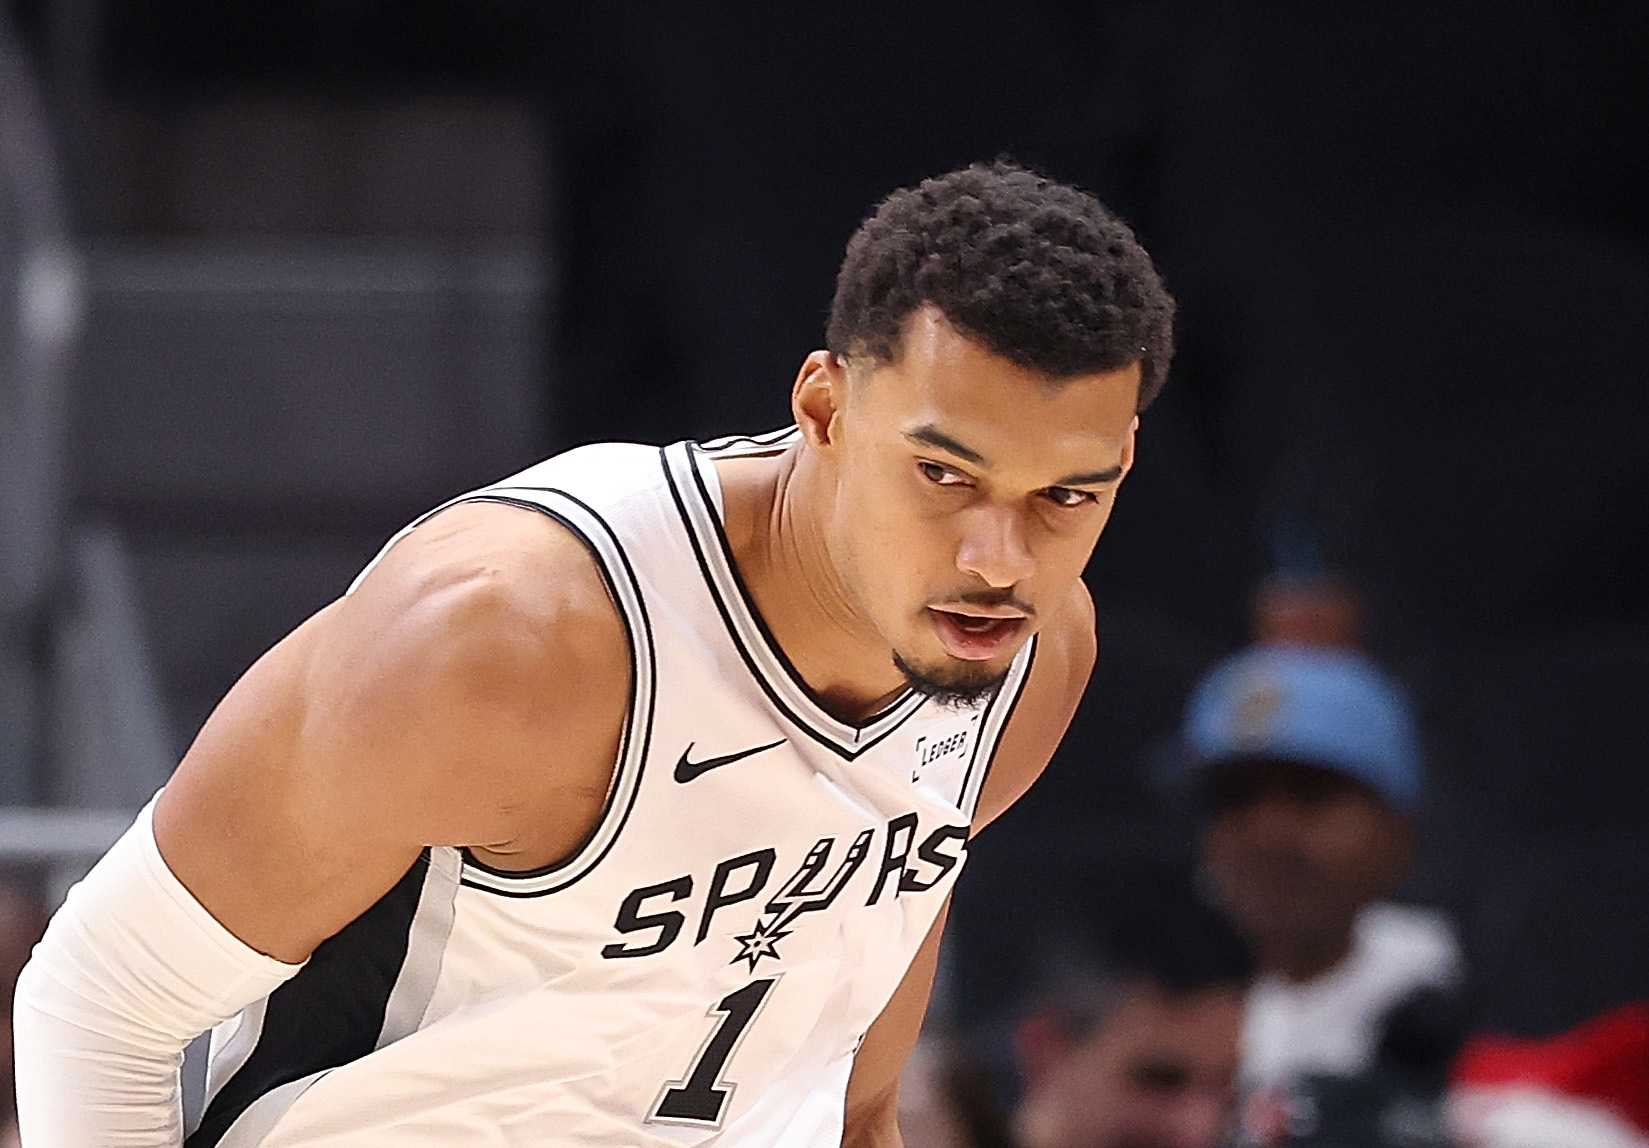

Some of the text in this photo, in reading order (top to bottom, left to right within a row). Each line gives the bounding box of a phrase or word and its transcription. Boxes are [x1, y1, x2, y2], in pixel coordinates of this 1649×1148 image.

[921, 730, 968, 767] LEDGER
[600, 811, 970, 962] SPURS
[644, 973, 784, 1131] 1
